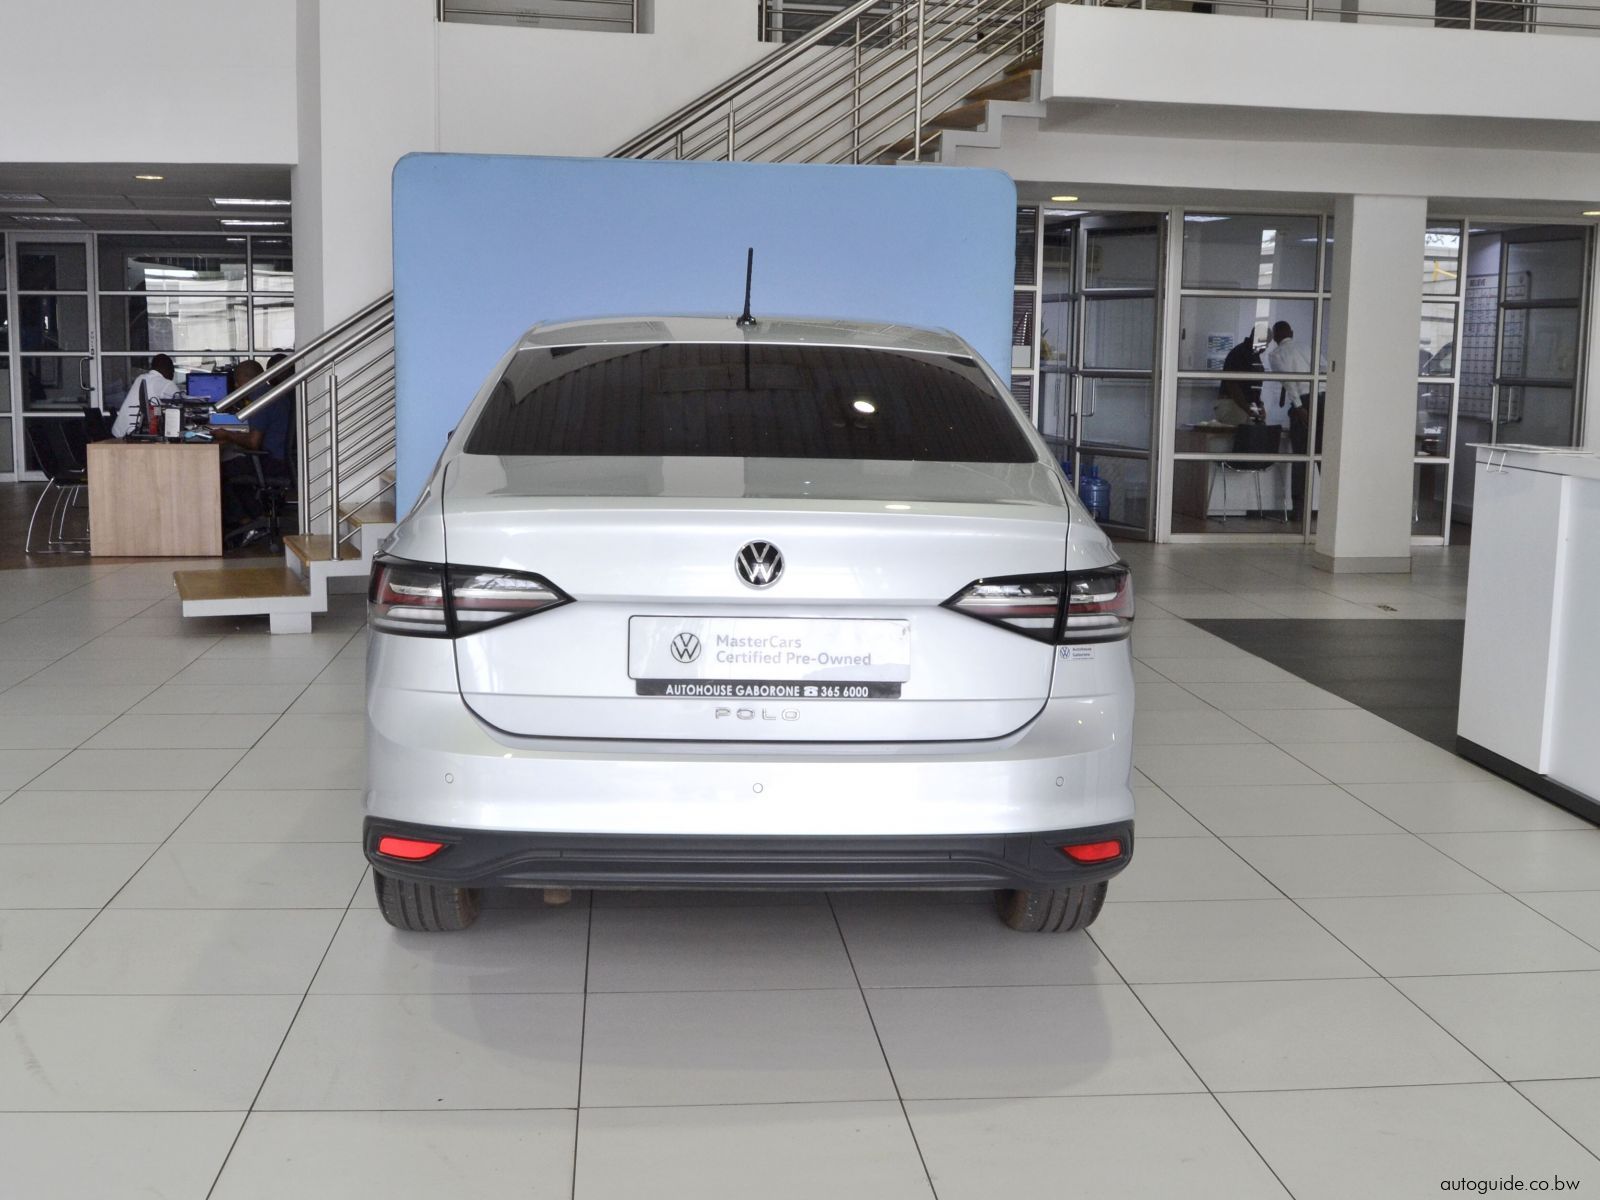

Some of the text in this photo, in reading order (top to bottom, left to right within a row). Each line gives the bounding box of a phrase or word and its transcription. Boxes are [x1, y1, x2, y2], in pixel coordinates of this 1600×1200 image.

[716, 634, 802, 649] MasterCars
[716, 650, 872, 666] Certified Pre-Owned
[666, 684, 869, 698] AUTOHOUSE GABORONE 365 6000
[714, 707, 801, 721] POLO
